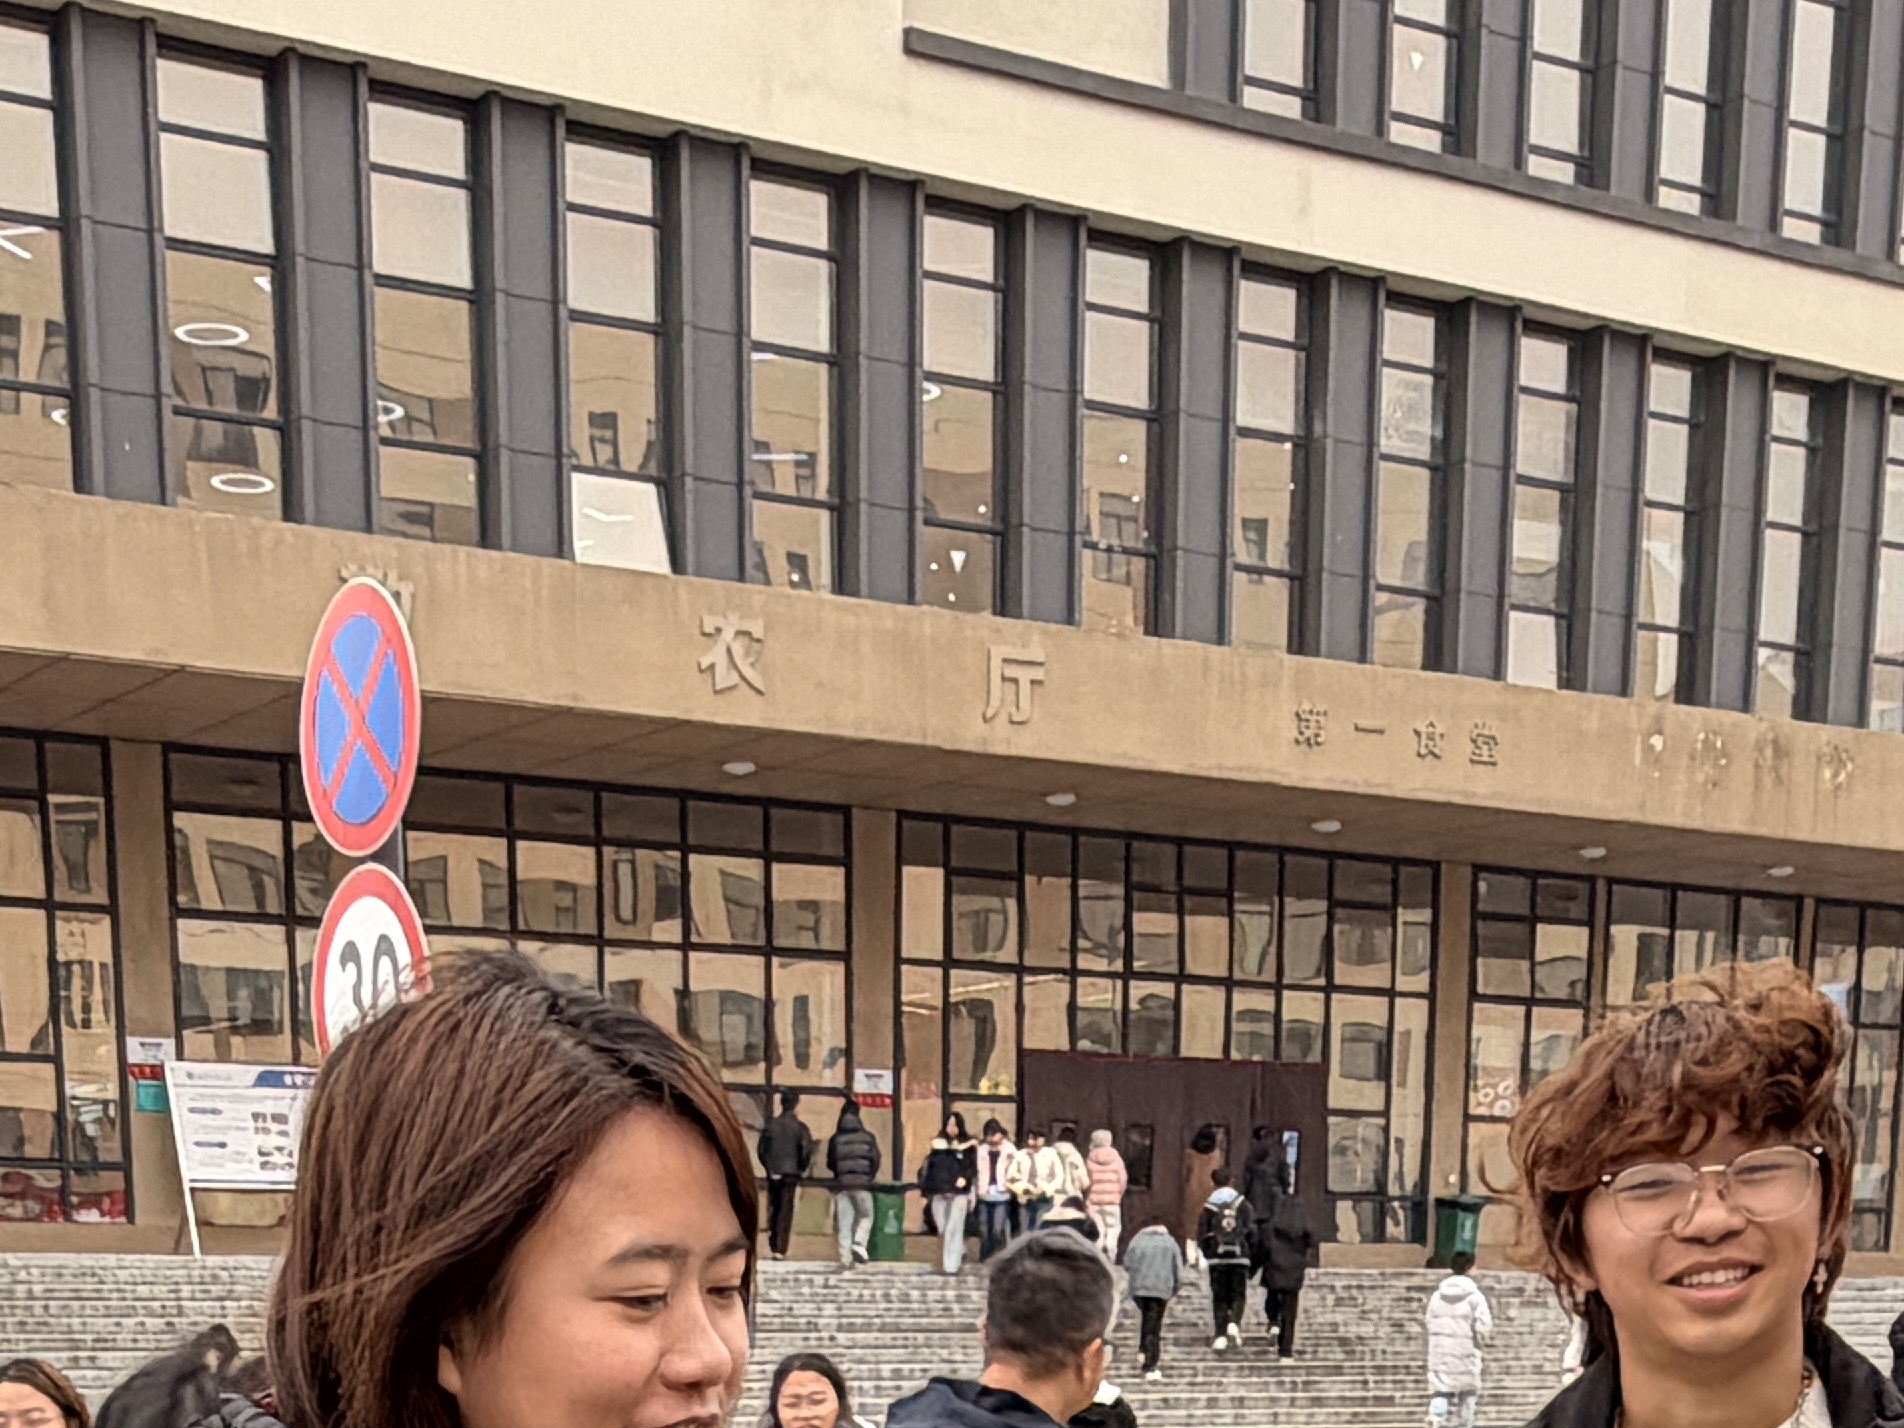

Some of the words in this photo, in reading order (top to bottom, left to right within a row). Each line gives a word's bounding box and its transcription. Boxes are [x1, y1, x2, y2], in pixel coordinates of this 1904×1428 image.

[1293, 702, 1500, 767] 第一食堂
[339, 932, 400, 1024] 30
